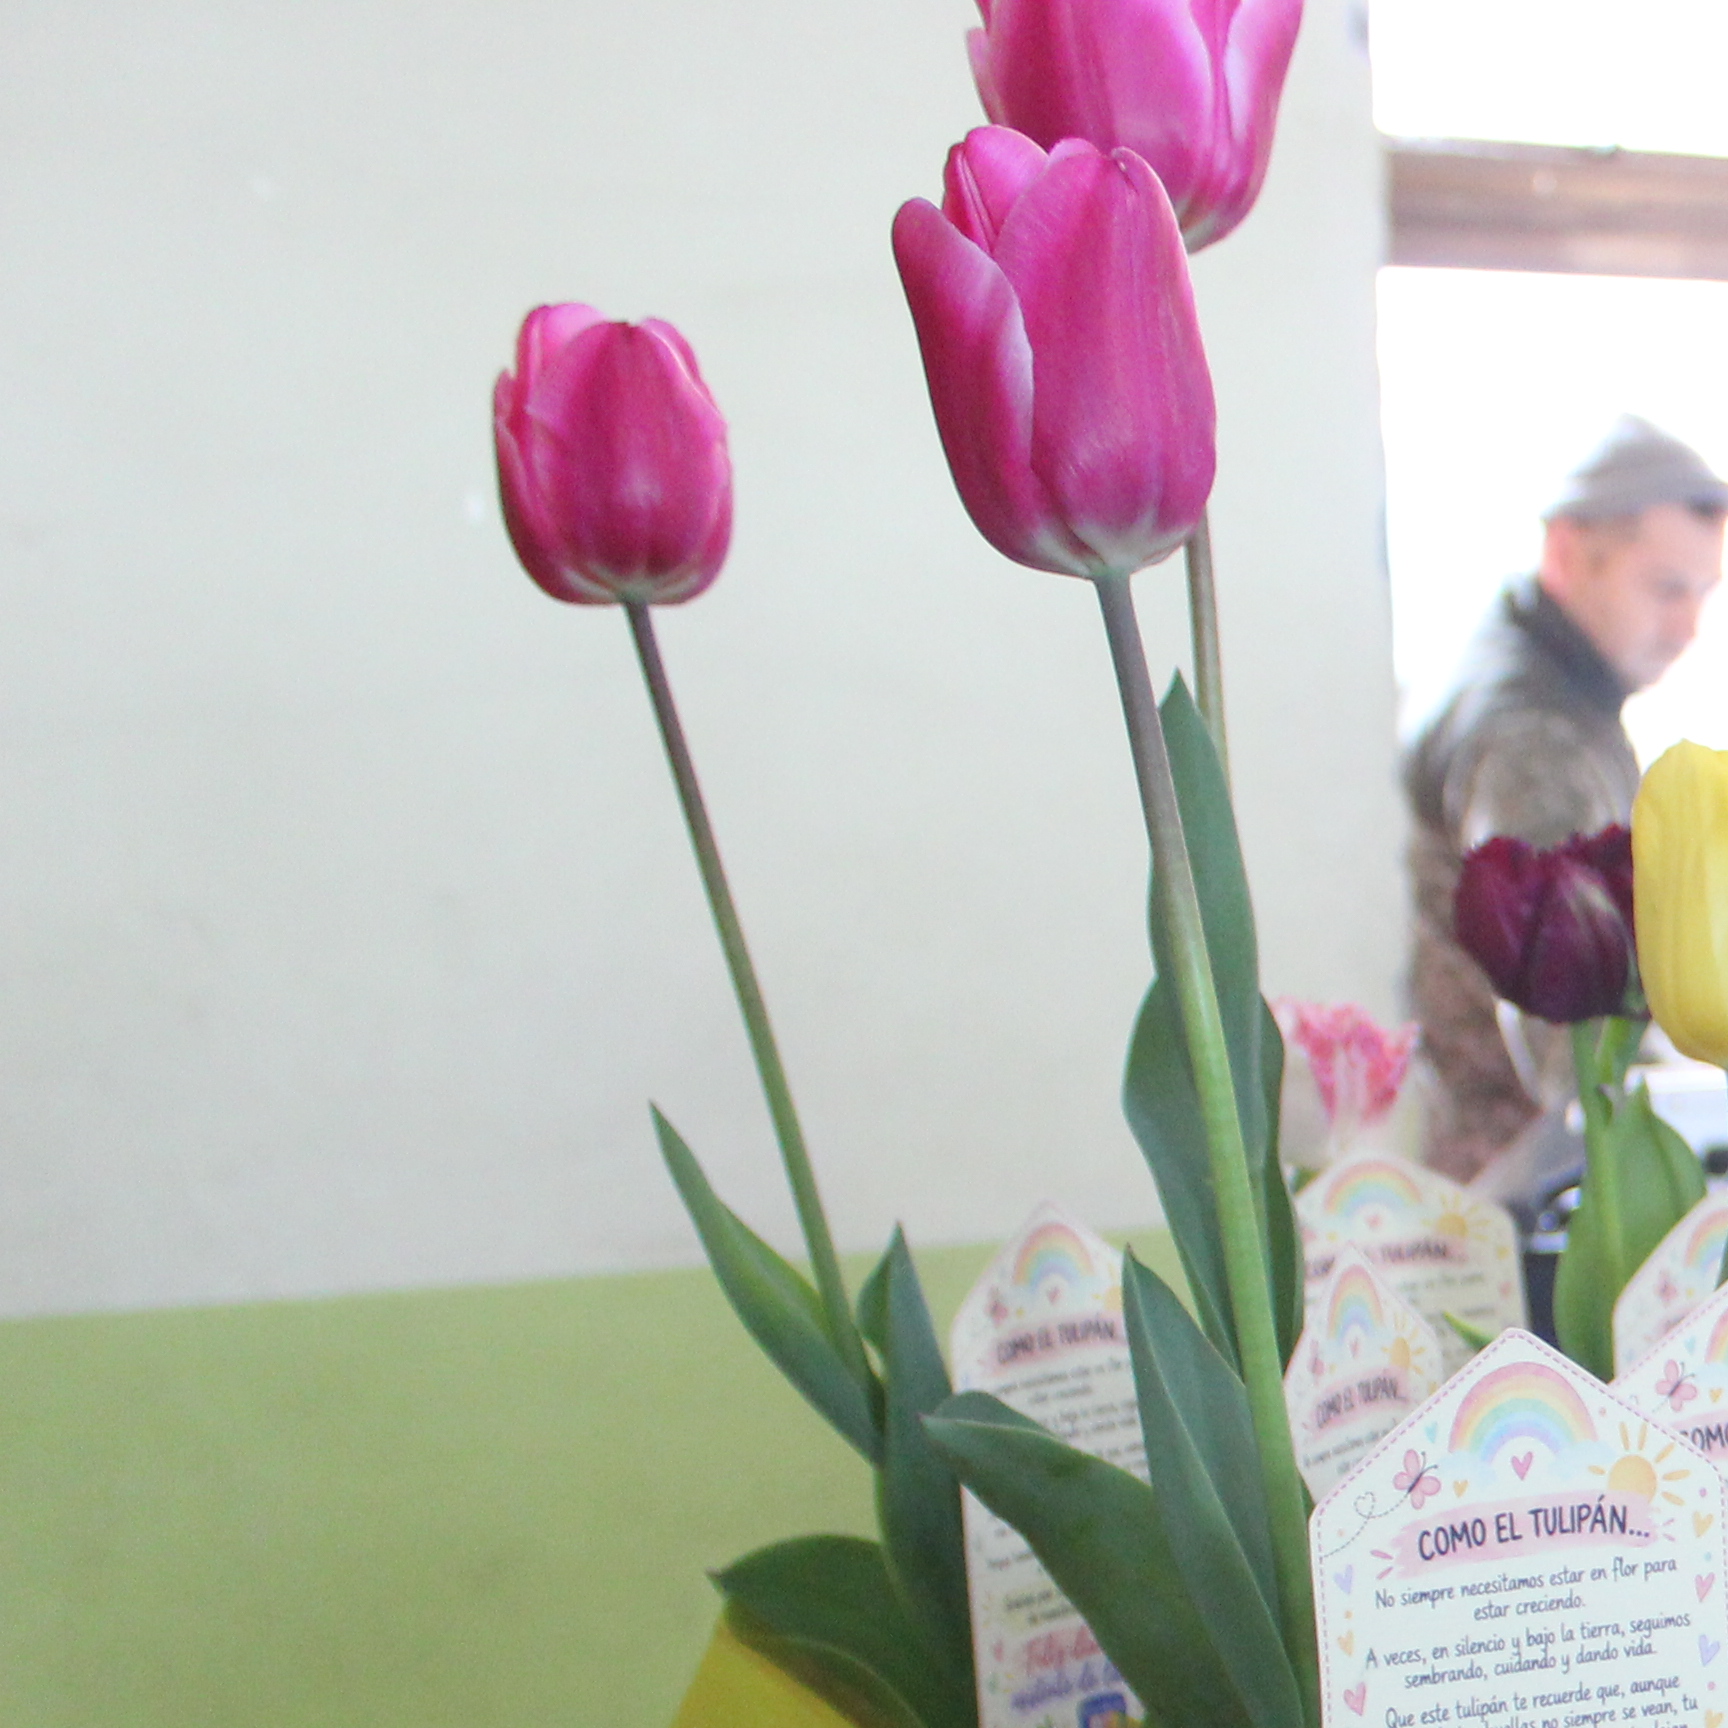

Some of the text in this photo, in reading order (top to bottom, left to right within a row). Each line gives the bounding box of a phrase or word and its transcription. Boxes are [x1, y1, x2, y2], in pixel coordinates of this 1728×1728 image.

[1417, 1493, 1650, 1561] COMO EL TULIPÁN...
[1374, 1555, 1677, 1609] No siempre necesitamos estar en flor para
[1472, 1588, 1585, 1621] estar creciendo.
[1365, 1612, 1691, 1669] A veces, en silencio y bajo la tierra, seguimos
[1404, 1658, 1488, 1689] sembrando,
[1493, 1648, 1557, 1676] cuidando
[1560, 1654, 1570, 1675] y
[1575, 1640, 1619, 1665] dando
[1419, 1702, 1450, 1725] este
[1454, 1694, 1508, 1722] tulipán
[1512, 1692, 1528, 1711] te
[1532, 1681, 1592, 1708] recuerde
[1595, 1683, 1625, 1705] que,
[1629, 1675, 1680, 1697] aunque
[1621, 1705, 1636, 1720] se
[1640, 1701, 1678, 1717] vean,
[1681, 1693, 1698, 1711] tu
